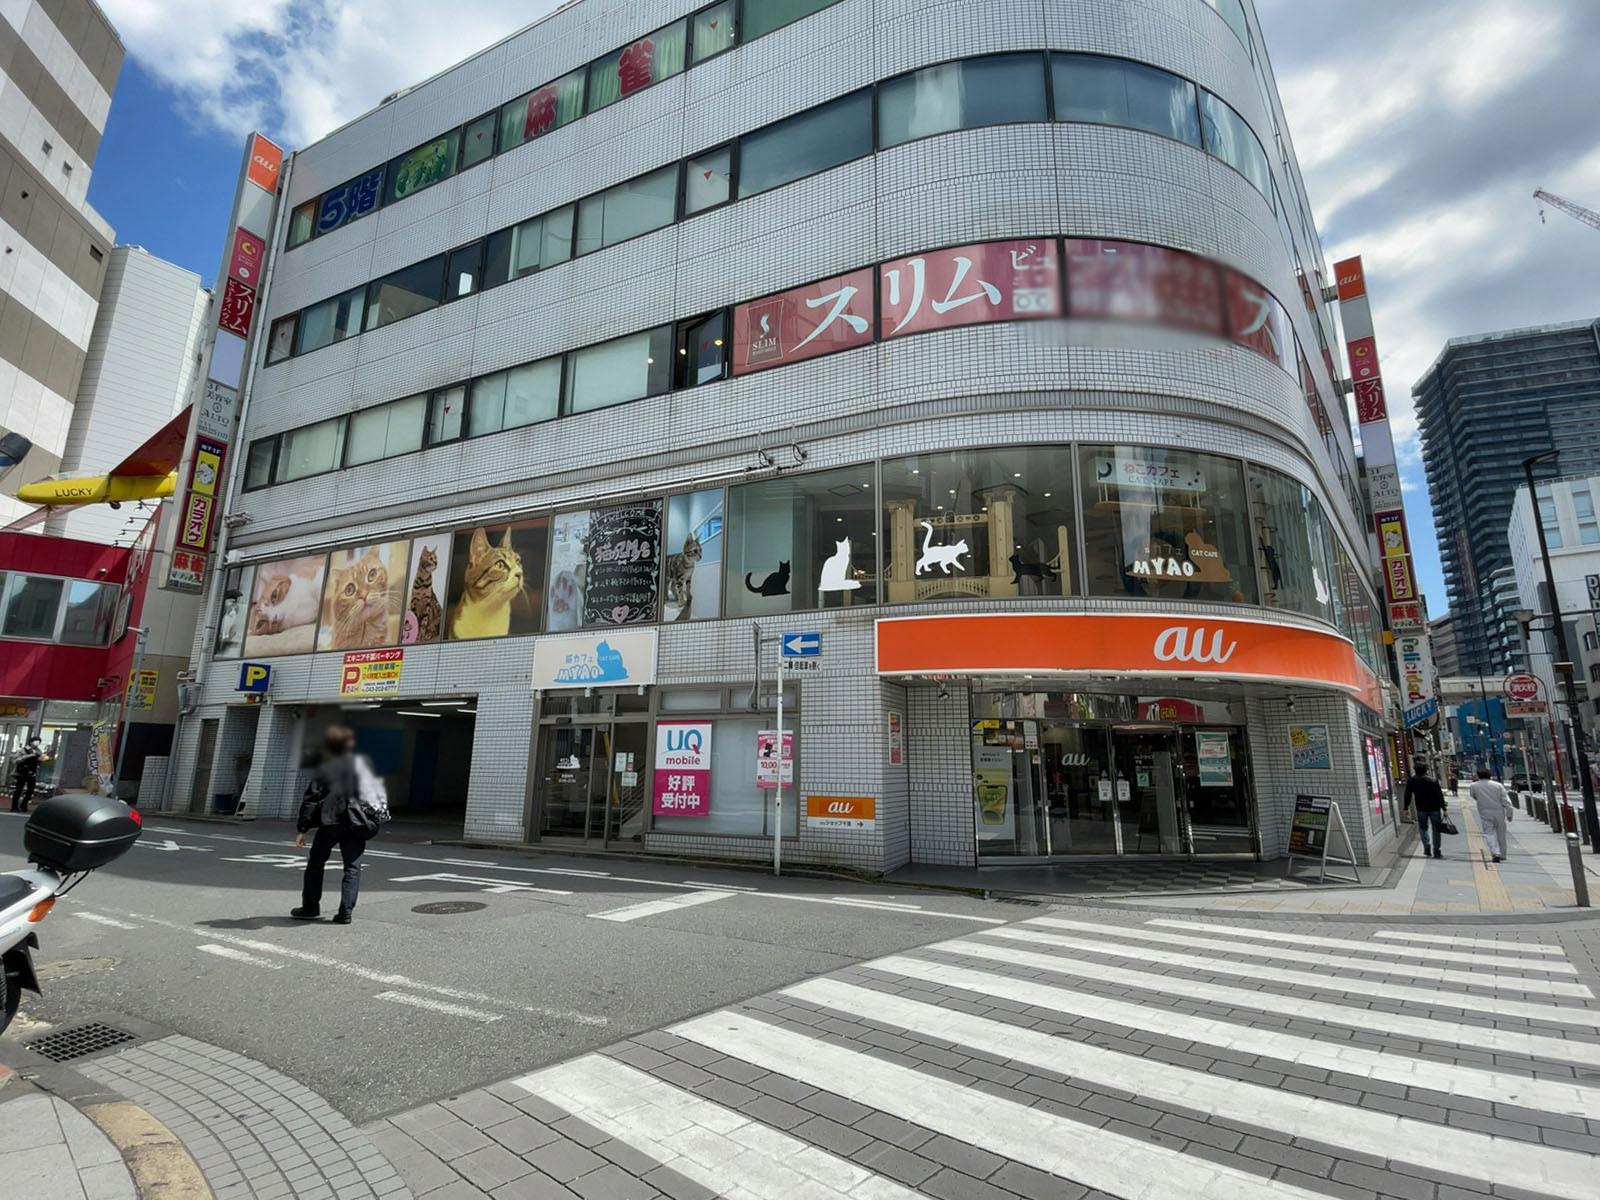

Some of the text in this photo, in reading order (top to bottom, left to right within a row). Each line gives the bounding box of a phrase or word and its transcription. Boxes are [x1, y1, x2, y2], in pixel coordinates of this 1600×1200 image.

[253, 155, 277, 171] au
[1339, 274, 1361, 286] au
[228, 284, 253, 335] スリム
[787, 256, 1003, 353] スリム
[752, 337, 777, 350] SLIM
[1365, 380, 1386, 421] スリム
[200, 408, 230, 427] ALTO
[1123, 463, 1181, 479] ねこカフェ
[1151, 477, 1175, 487] CAFE
[55, 487, 94, 498] LUCKY
[1373, 489, 1399, 498] ALTO
[187, 497, 208, 544] カラオケ
[173, 552, 206, 573] 麻雀
[1191, 549, 1218, 559] CAT CAFE
[1132, 557, 1194, 577] MYAO
[1391, 560, 1408, 597] カラオケ
[1153, 626, 1237, 664] au
[246, 666, 267, 687] P
[341, 667, 361, 693] P
[558, 664, 601, 680] MYAO
[1406, 700, 1433, 722] LUCKY
[666, 729, 703, 755] UQ
[666, 756, 701, 765] mobile
[1061, 753, 1091, 766] au
[668, 774, 696, 791] 好評
[661, 792, 701, 809] 受付中
[828, 801, 855, 814] au
